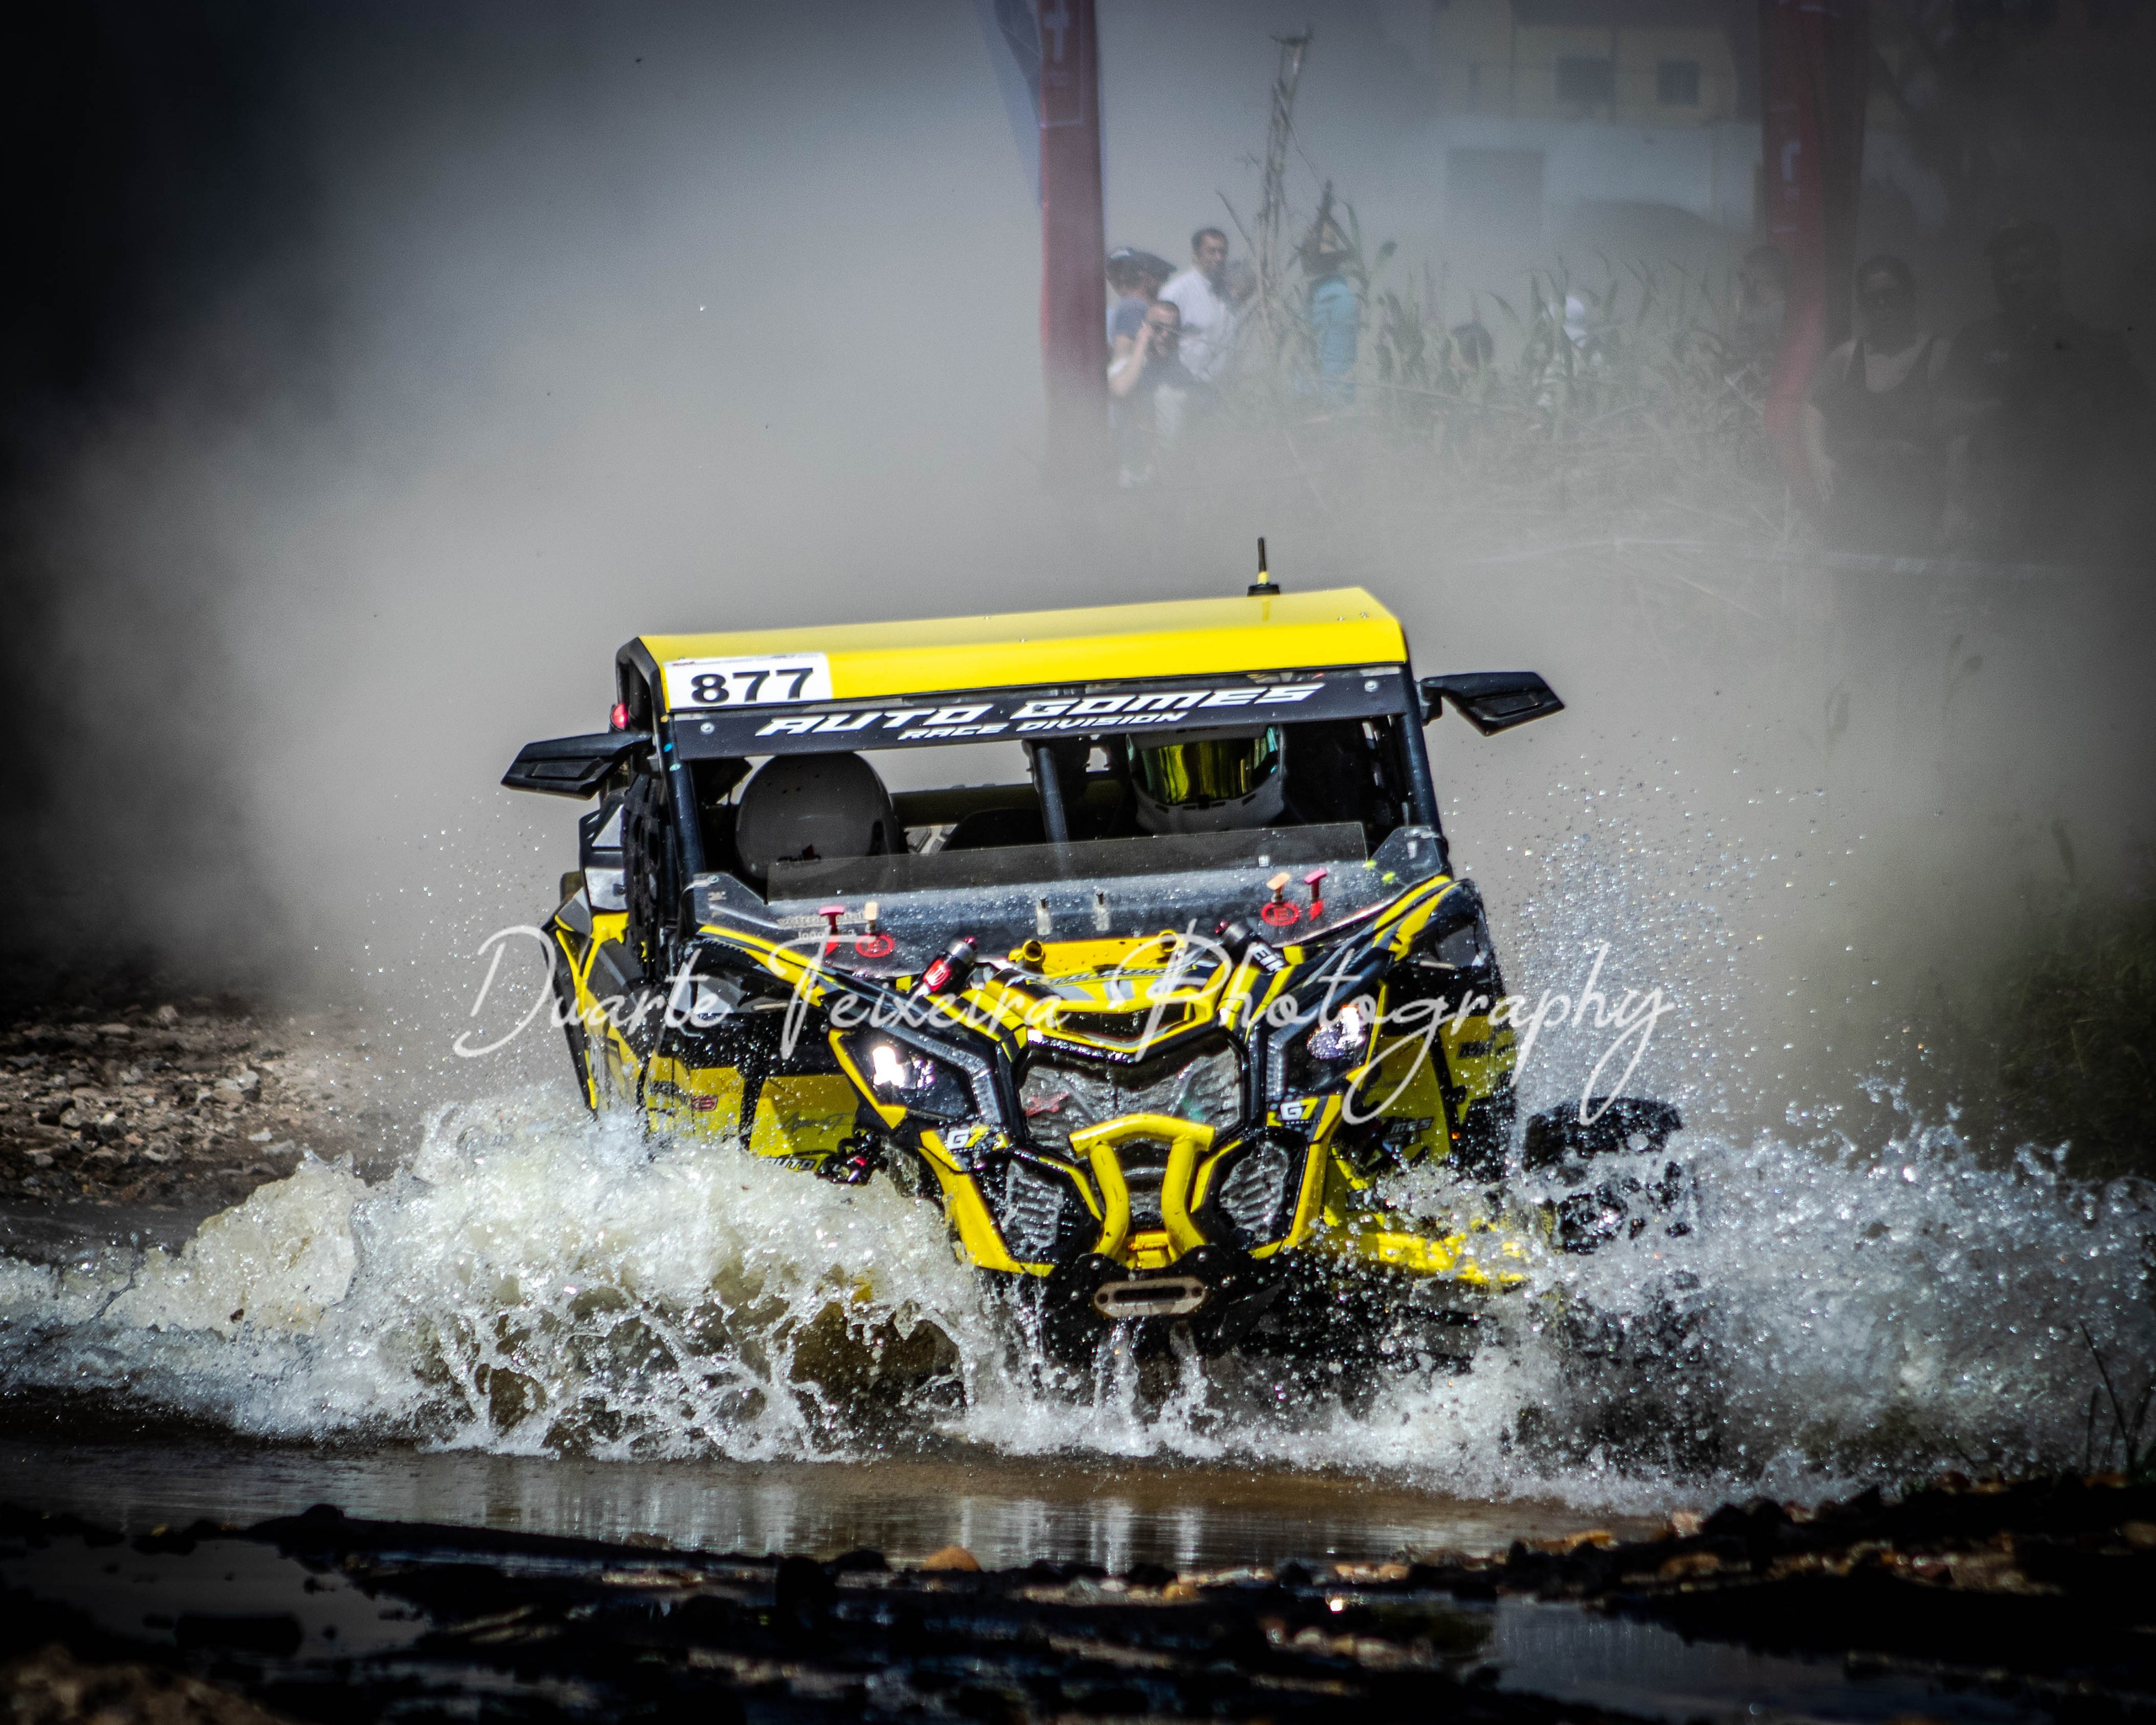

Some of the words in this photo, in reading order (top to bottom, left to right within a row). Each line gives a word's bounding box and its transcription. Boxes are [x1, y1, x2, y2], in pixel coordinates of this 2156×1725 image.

[691, 667, 814, 704] 877
[755, 702, 995, 737] AUTO
[1010, 681, 1326, 720] GOMES
[897, 722, 1009, 741] RACE
[1016, 711, 1188, 733] DIVISION
[1280, 1097, 1319, 1121] G7
[945, 1123, 990, 1151] G7
